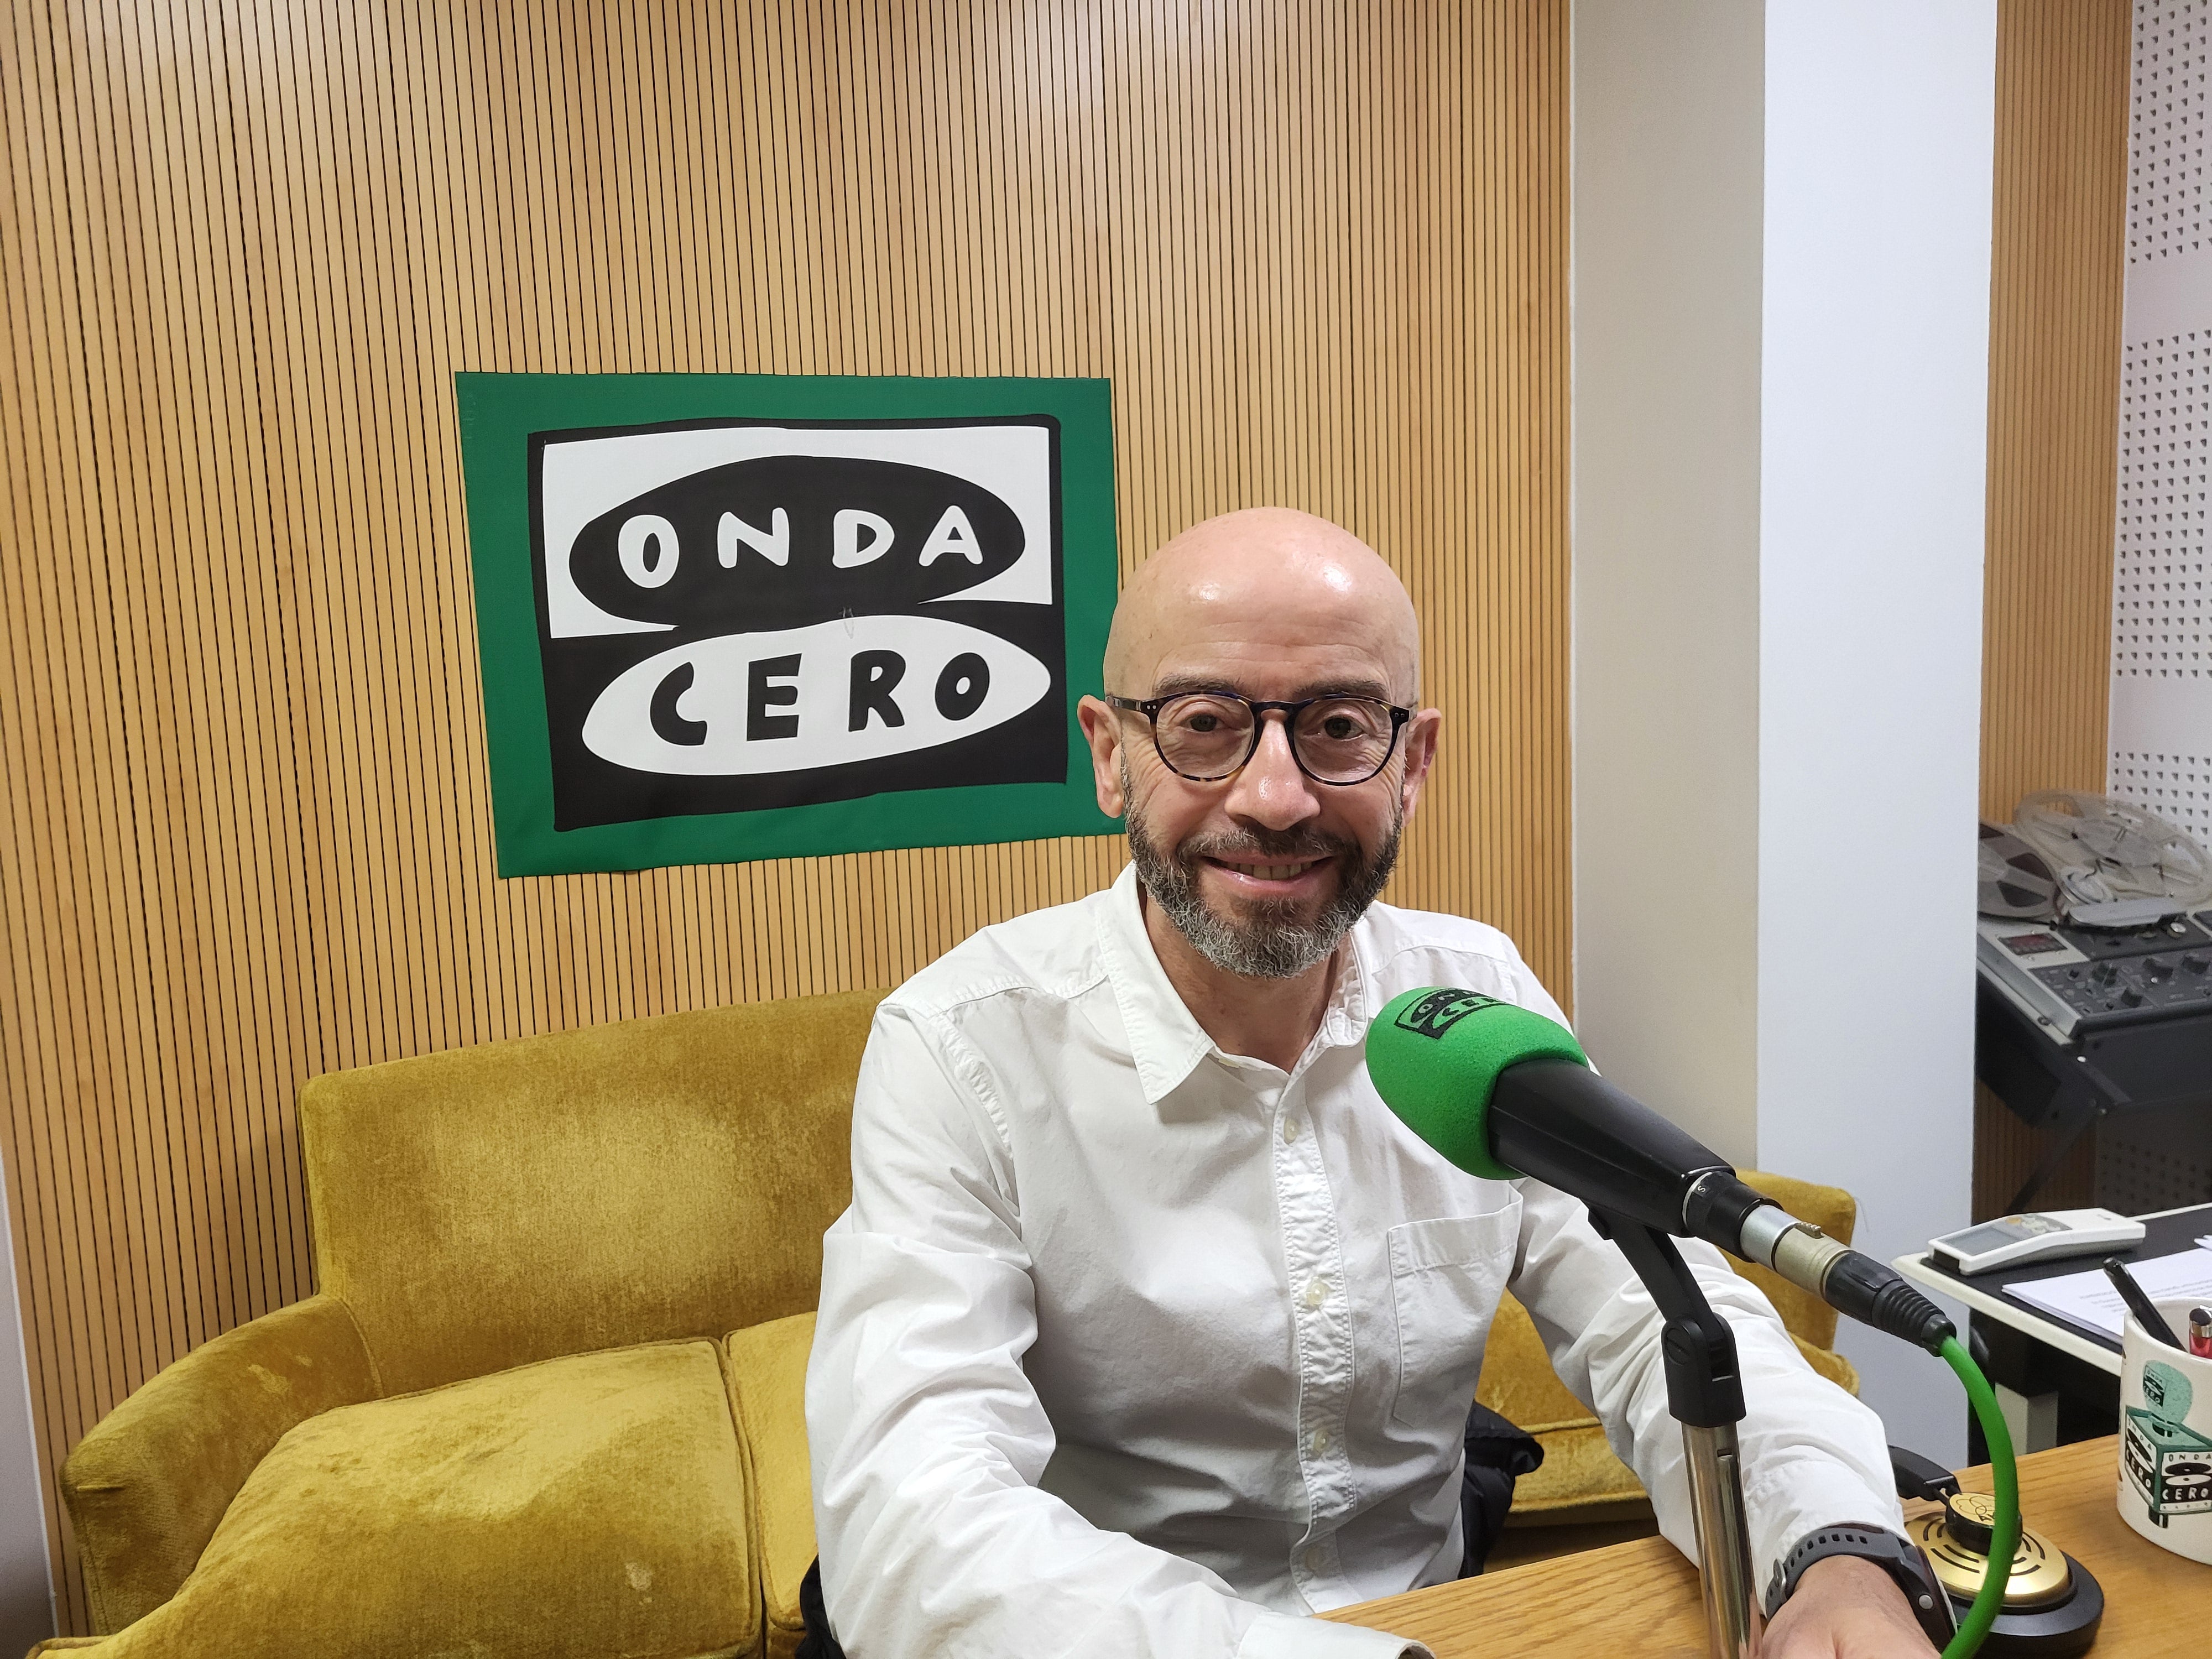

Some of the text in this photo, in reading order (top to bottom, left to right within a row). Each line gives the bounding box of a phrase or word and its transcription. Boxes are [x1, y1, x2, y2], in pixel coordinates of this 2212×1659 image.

[618, 505, 983, 588] ONDA
[650, 649, 990, 746] CERO
[2168, 1453, 2212, 1462] ONDA
[2162, 1486, 2209, 1500] CERO
